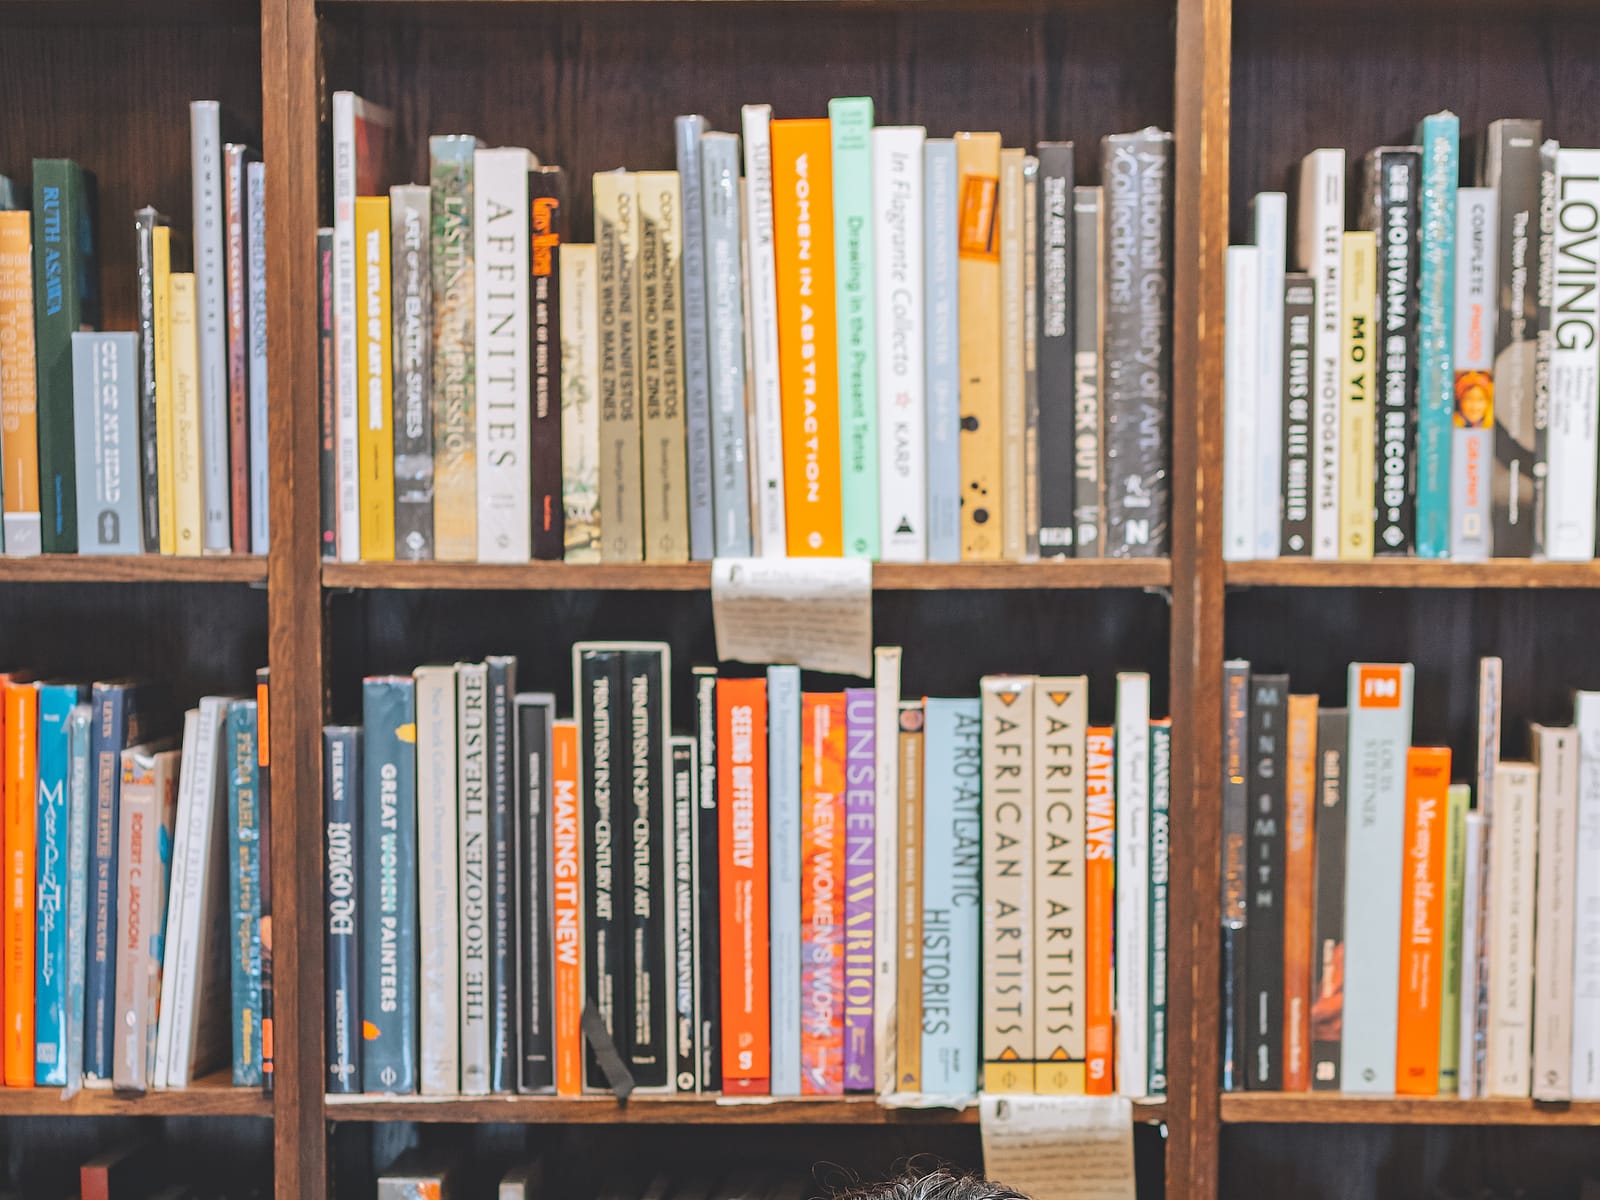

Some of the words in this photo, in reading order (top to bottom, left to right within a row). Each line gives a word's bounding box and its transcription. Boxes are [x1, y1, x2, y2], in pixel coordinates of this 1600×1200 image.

[891, 153, 909, 179] In
[44, 187, 60, 241] RUTH
[405, 207, 420, 248] ART
[795, 154, 810, 260] WOMEN
[890, 181, 911, 281] Flagrante
[1111, 154, 1136, 302] Collections
[1138, 154, 1165, 269] National
[1324, 226, 1336, 255] LEE
[367, 231, 379, 260] THE
[444, 197, 465, 307] LASTING
[601, 220, 614, 281] ARTISTS
[618, 241, 631, 315] MACHINE
[643, 218, 656, 280] ARTISTS
[661, 241, 674, 314] MACHINE
[846, 216, 863, 289] Drawing
[1387, 207, 1408, 330] MORIYAMA
[1470, 204, 1484, 295] COMPLETE
[1556, 175, 1597, 351] LOVING
[45, 247, 61, 315] ASAWA
[367, 263, 380, 316] ATLAS
[602, 286, 614, 326] WHO
[644, 285, 657, 325] WHO
[800, 269, 812, 296] IN
[851, 296, 865, 313] in
[1324, 267, 1336, 332] MILLER
[488, 199, 515, 467] AFFINITIES
[602, 331, 615, 374] MAKE
[645, 330, 658, 373] MAKE
[851, 319, 866, 346] the
[892, 288, 912, 376] Collecto
[1137, 274, 1164, 364] Gallery
[1351, 316, 1365, 362] MO
[368, 342, 381, 373] ART
[620, 321, 633, 422] MANIFESTOS
[663, 319, 676, 419] MANIFESTOS
[850, 351, 867, 416] Present
[1075, 352, 1096, 428] BLACK
[1141, 371, 1162, 400] of
[1351, 375, 1365, 401] YI
[406, 372, 422, 438] STATES
[444, 321, 467, 487] IMPRESSIONS
[604, 377, 616, 422] ZINES
[646, 376, 660, 419] ZINES
[801, 304, 819, 502] ABSTRACTION
[1141, 405, 1162, 445] Art
[853, 422, 868, 473] Tense
[895, 422, 909, 477] KARP
[1077, 434, 1097, 481] OUT
[1322, 359, 1335, 509] PHOTOGRAPHS
[1384, 412, 1405, 507] RECORD
[465, 676, 483, 820] TREASURE
[731, 706, 751, 763] SEEING
[1379, 739, 1394, 792] LOUIS
[332, 741, 344, 800] PELIKAN
[381, 764, 397, 830] GREAT
[846, 700, 874, 867] UNSEEN
[996, 717, 1021, 878] AFRICAN
[1047, 716, 1072, 878] AFRICAN
[1086, 735, 1111, 860] GATEWAYS
[1152, 731, 1169, 811] JAPANESE
[1362, 739, 1377, 827] STETTNER
[130, 812, 143, 865] ROBERT
[555, 781, 576, 878] MAKING
[732, 766, 753, 867] DIFFERENTLY
[813, 793, 832, 847] NEW
[952, 713, 979, 907] AFRO-ATLANTIC
[129, 867, 141, 880] C.
[328, 822, 352, 897] IMAGO
[381, 834, 397, 912] WOMEN
[595, 820, 610, 888] CENTURY
[633, 818, 648, 886] CENTURY
[128, 885, 141, 949] JACKSON
[466, 831, 484, 960] ROGOZEN
[556, 883, 576, 903] IT
[596, 890, 612, 919] ART
[635, 888, 650, 917] ART
[381, 917, 397, 1012] PAINTERS
[557, 909, 576, 964] NEW
[846, 873, 874, 1026] WARHOL
[996, 901, 1022, 1035] ARTISTS
[1048, 900, 1073, 1035] ARTISTS
[467, 973, 484, 1025] THE
[812, 967, 831, 1038] WORK
[923, 910, 950, 1035] HISTORIES
